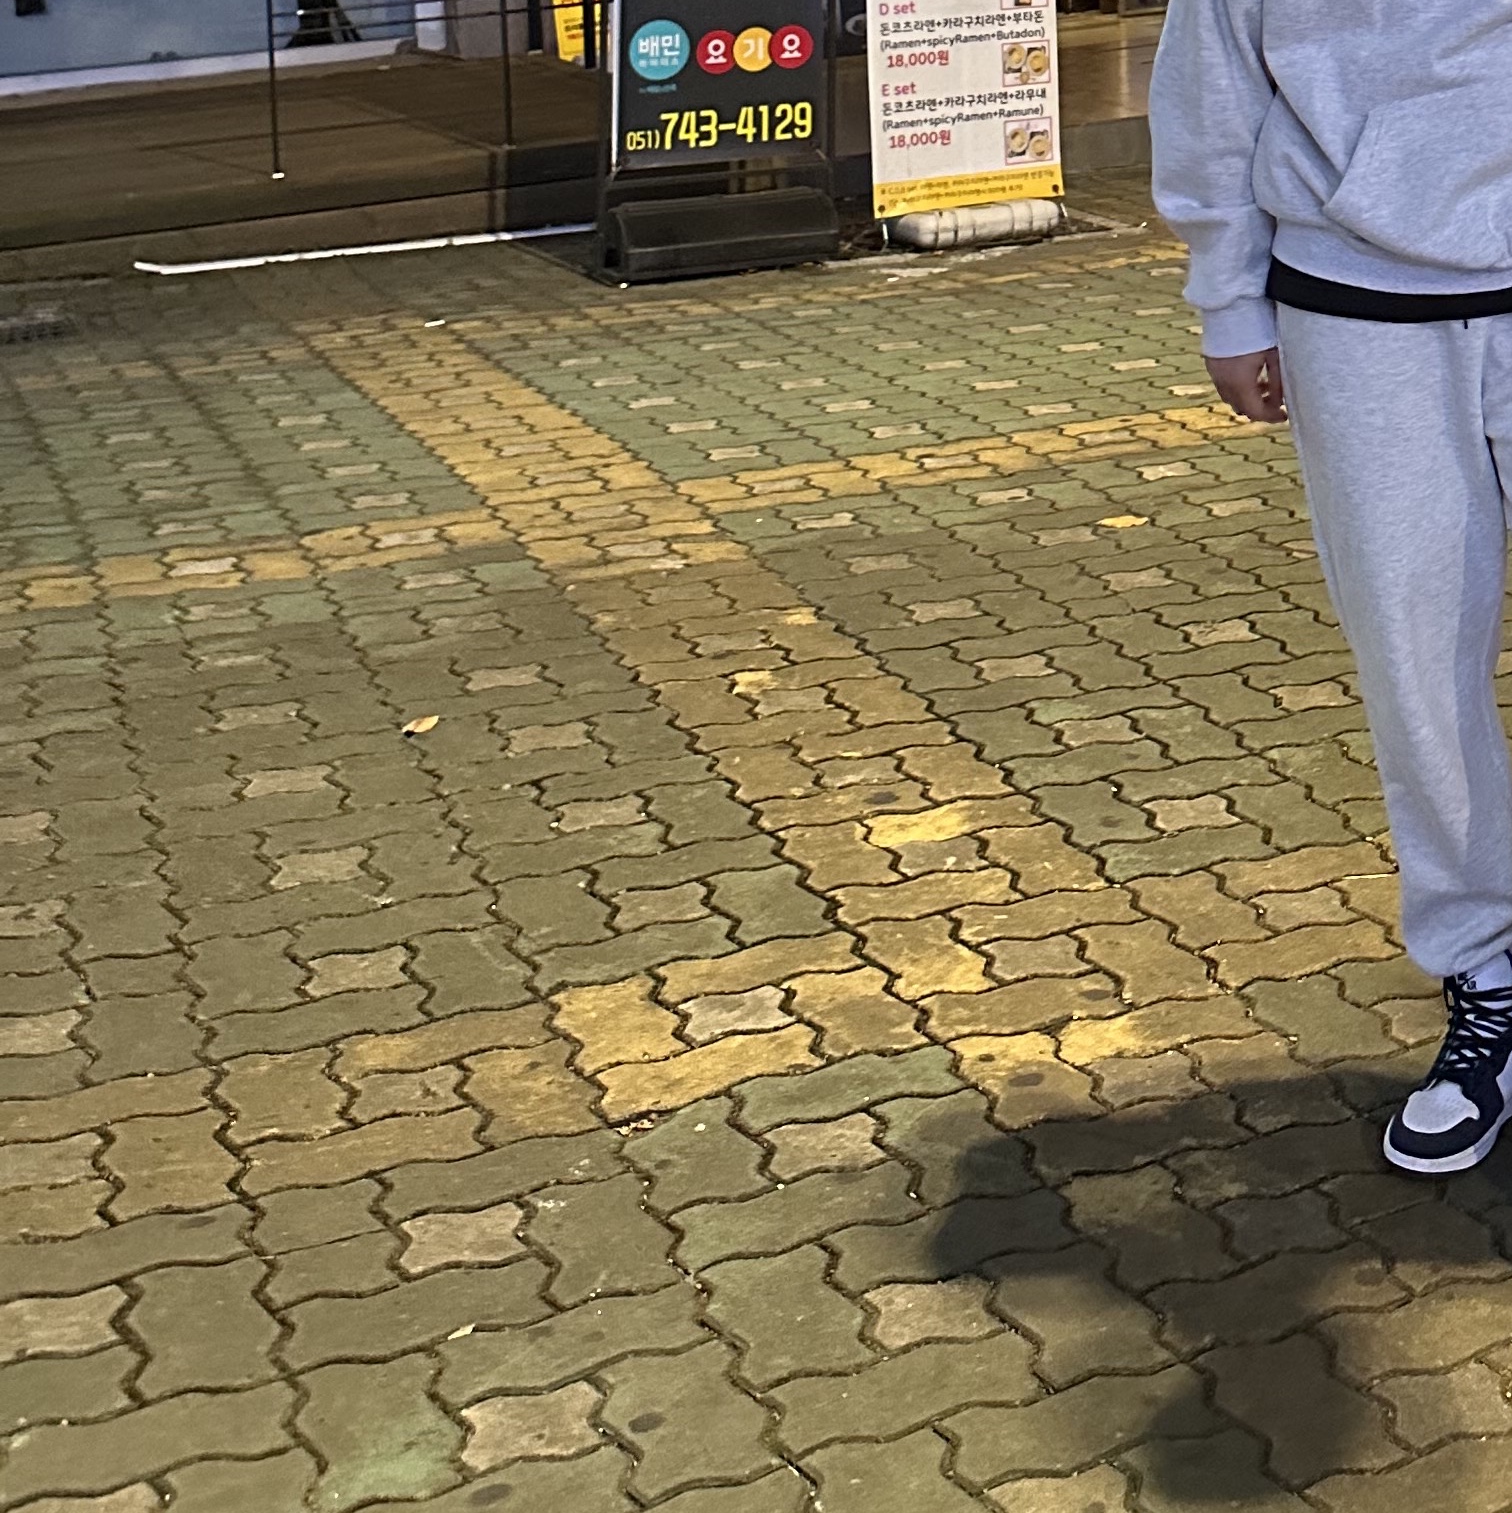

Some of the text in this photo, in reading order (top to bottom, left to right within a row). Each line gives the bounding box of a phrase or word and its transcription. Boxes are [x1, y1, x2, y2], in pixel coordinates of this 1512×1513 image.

[879, 0, 916, 15] D set
[638, 33, 680, 58] 배민
[704, 33, 803, 65] 요기요
[887, 50, 950, 68] 18,000원
[882, 82, 916, 96] E set
[889, 129, 951, 149] 18,000원
